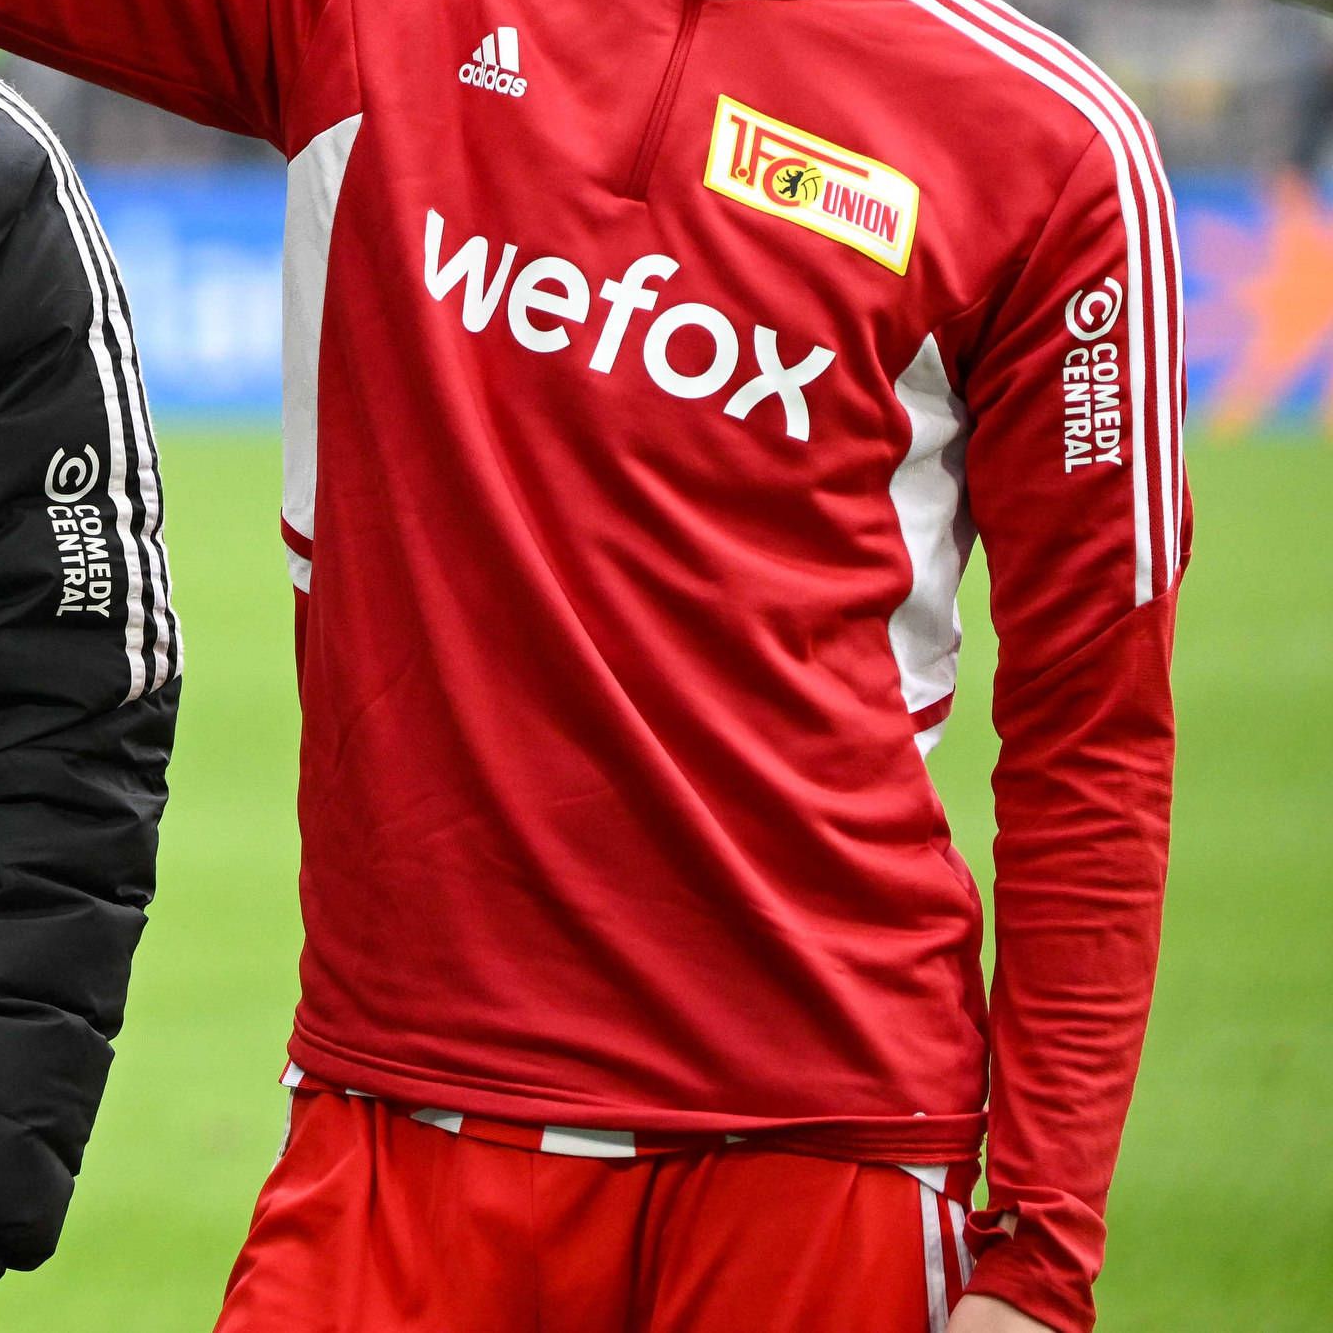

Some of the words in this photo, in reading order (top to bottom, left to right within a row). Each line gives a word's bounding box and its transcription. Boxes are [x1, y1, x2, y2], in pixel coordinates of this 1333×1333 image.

[822, 180, 900, 244] UNION
[424, 208, 836, 442] wefox
[1062, 347, 1093, 474] CENTRAL
[1091, 342, 1122, 466] COMEDY
[46, 505, 86, 617] CENTRAL
[73, 504, 112, 618] COMEDY
